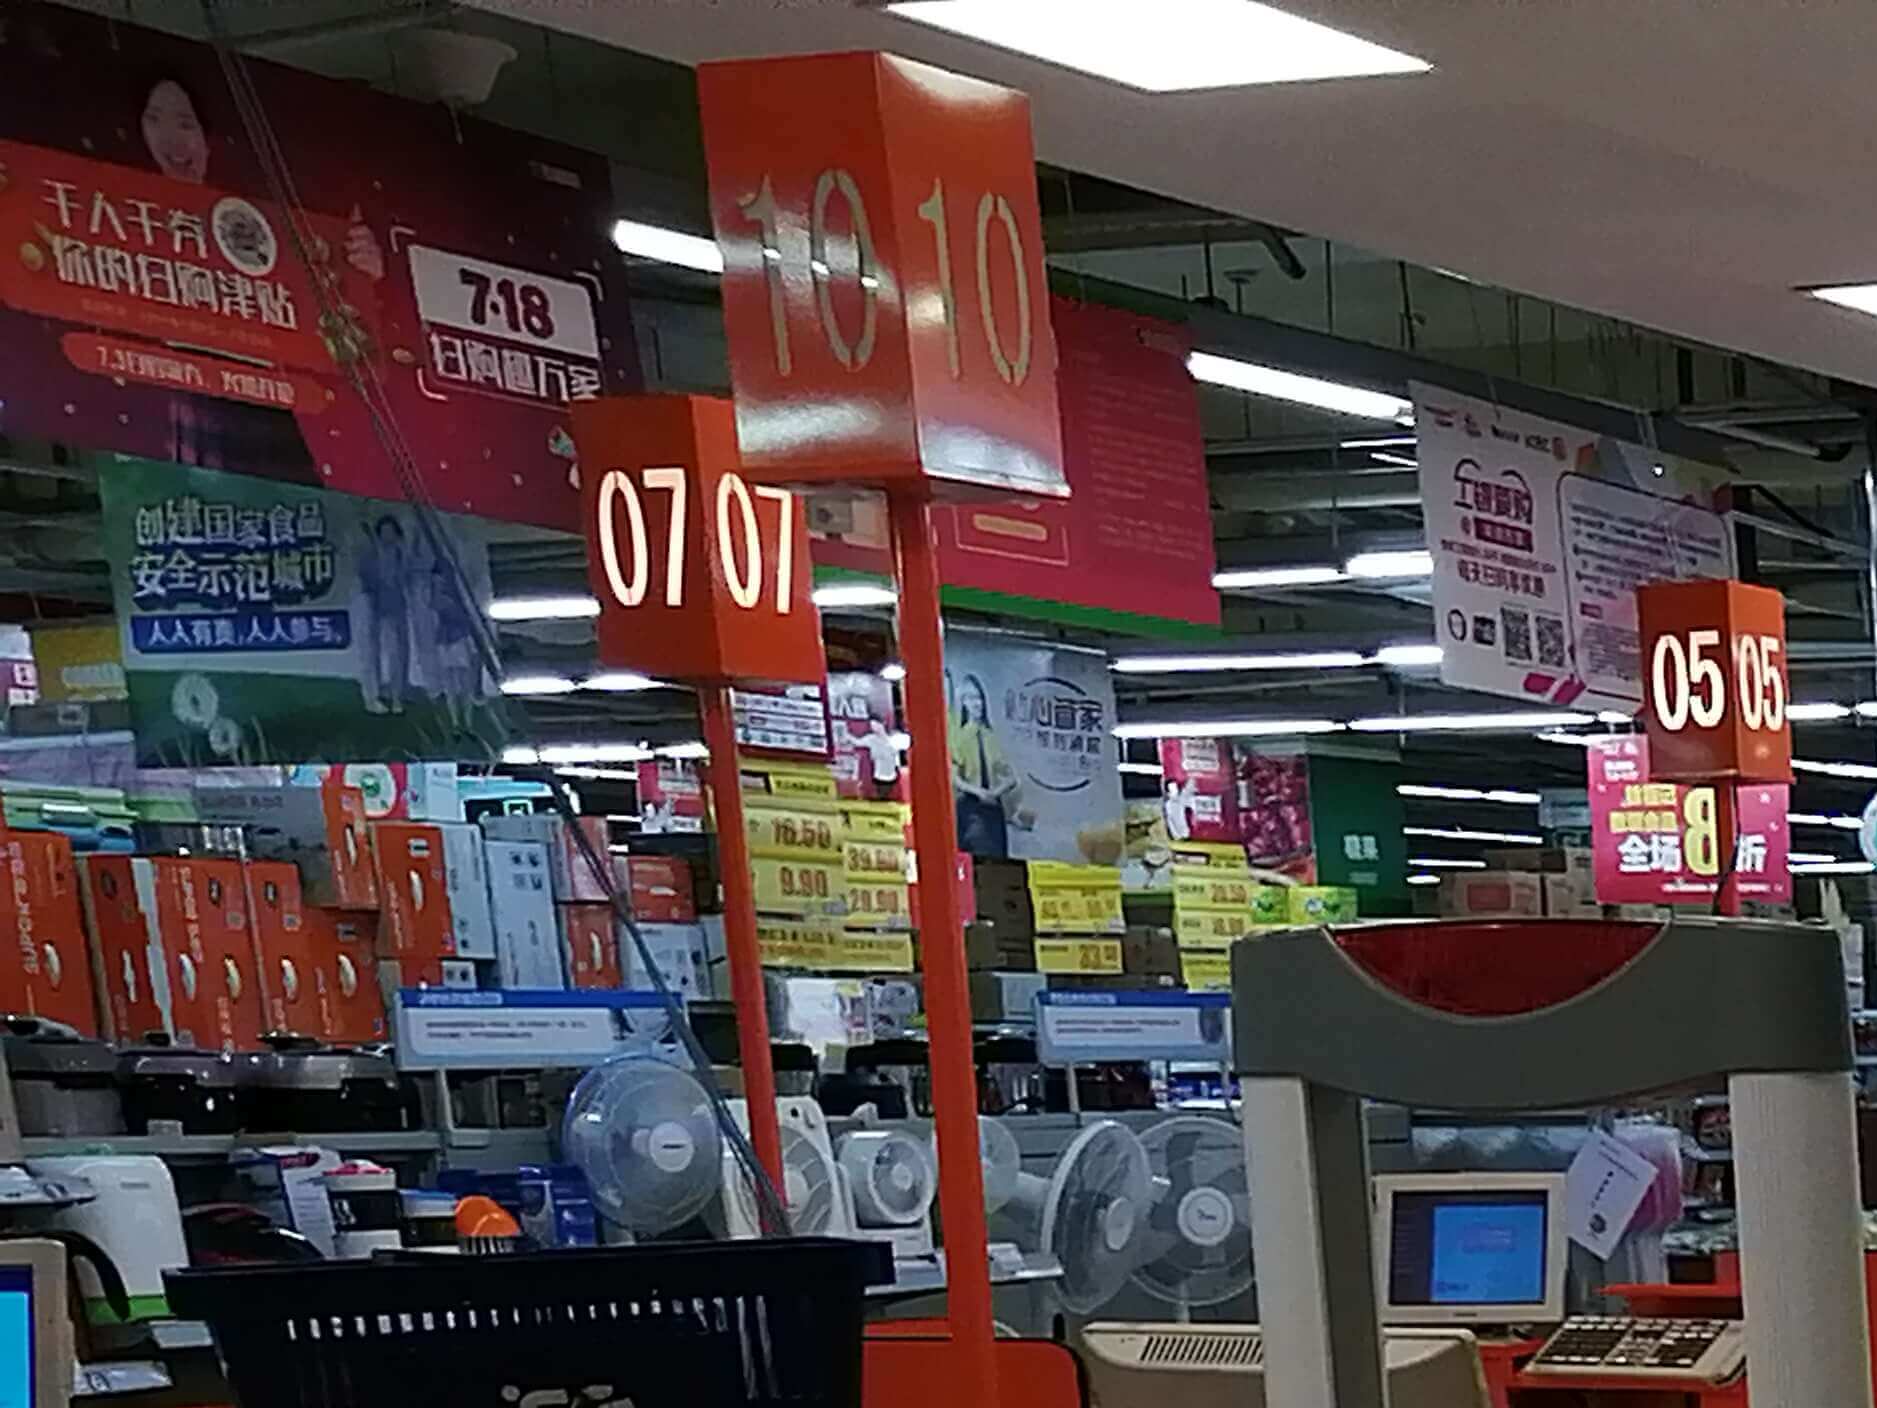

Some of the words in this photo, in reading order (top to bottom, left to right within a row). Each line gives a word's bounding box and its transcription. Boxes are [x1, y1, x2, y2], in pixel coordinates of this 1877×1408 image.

[738, 168, 880, 378] 10
[917, 178, 1030, 386] 10
[129, 544, 333, 602] 安全示范城市
[136, 497, 325, 549] 创建国家食品
[601, 470, 687, 607] 07
[718, 472, 795, 614] 07
[1651, 629, 1726, 732] 05
[1739, 634, 1784, 731] 05
